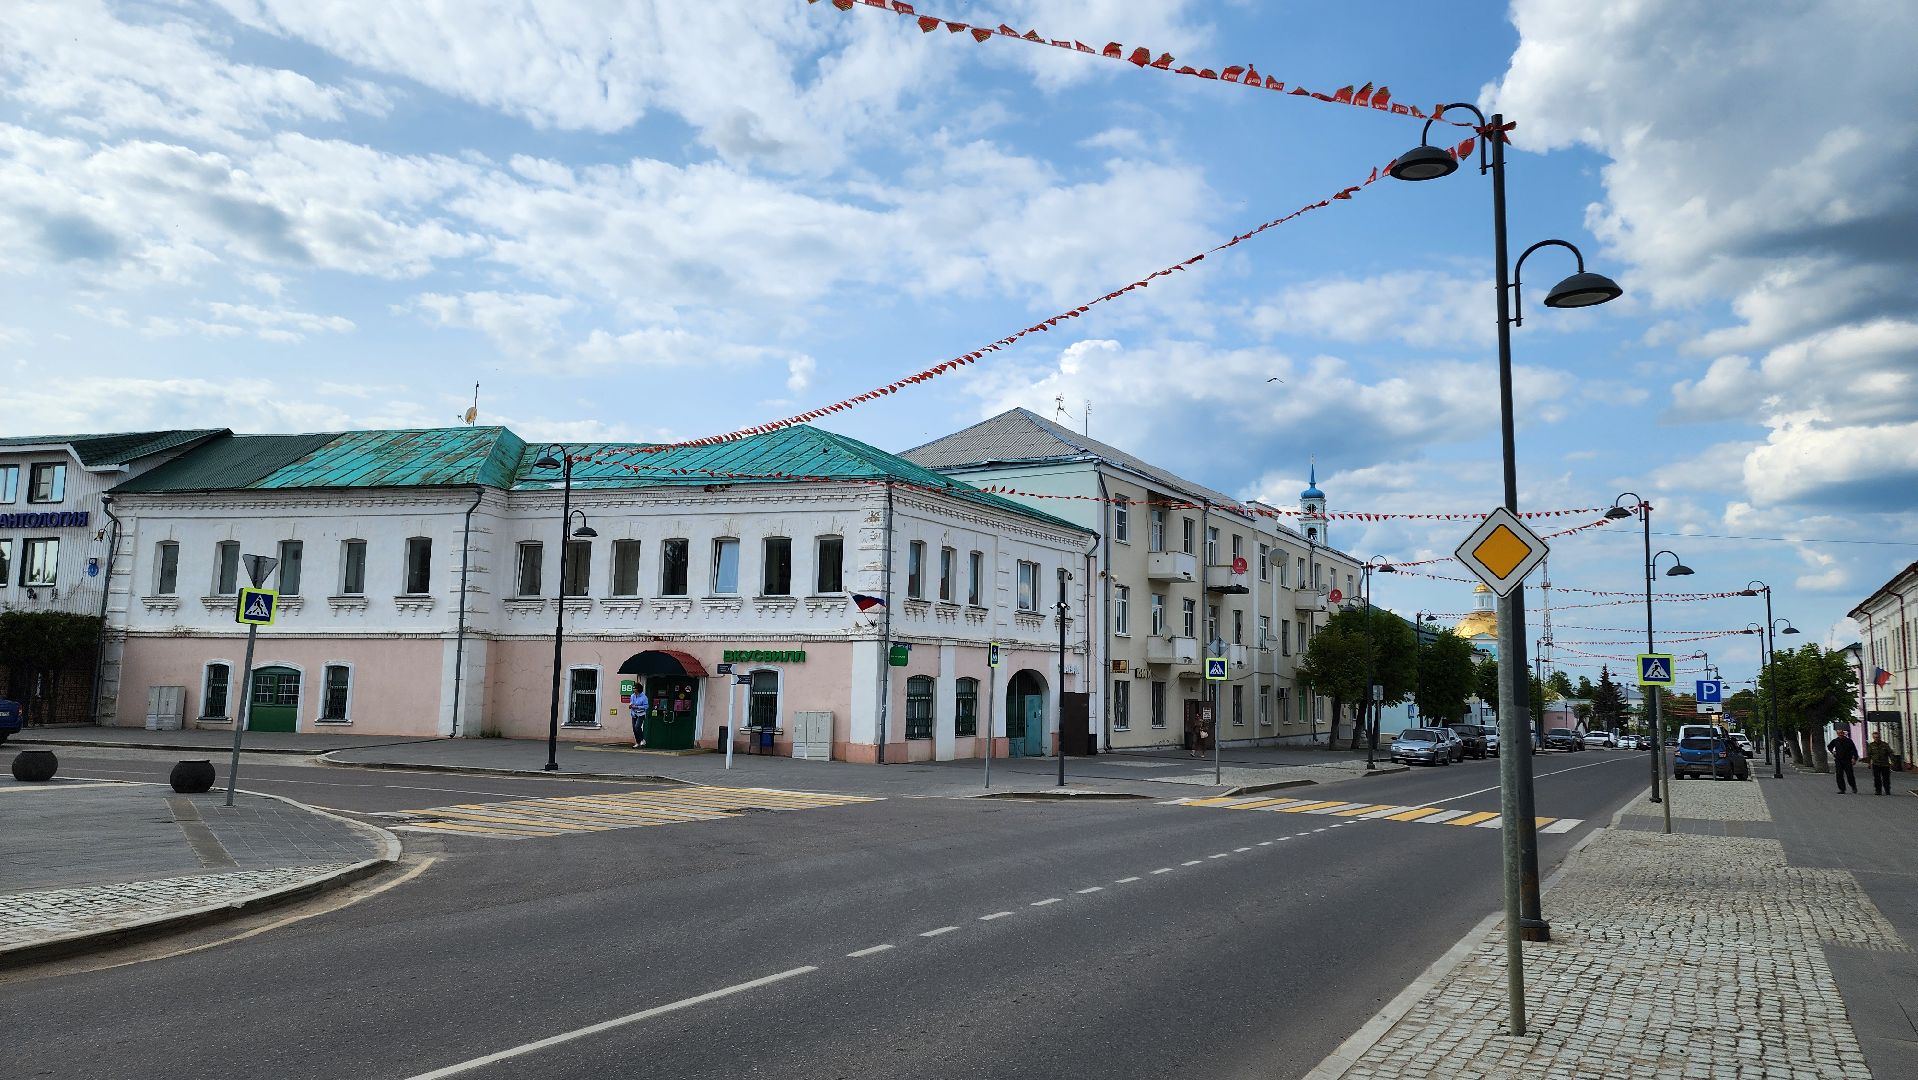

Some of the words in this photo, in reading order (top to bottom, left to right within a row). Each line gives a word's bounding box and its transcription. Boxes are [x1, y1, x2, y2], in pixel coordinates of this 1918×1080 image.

[0, 512, 89, 528] АНТОЛОГИЯ
[724, 650, 806, 662] ВКУСВИЛЛ
[1703, 682, 1716, 700] P
